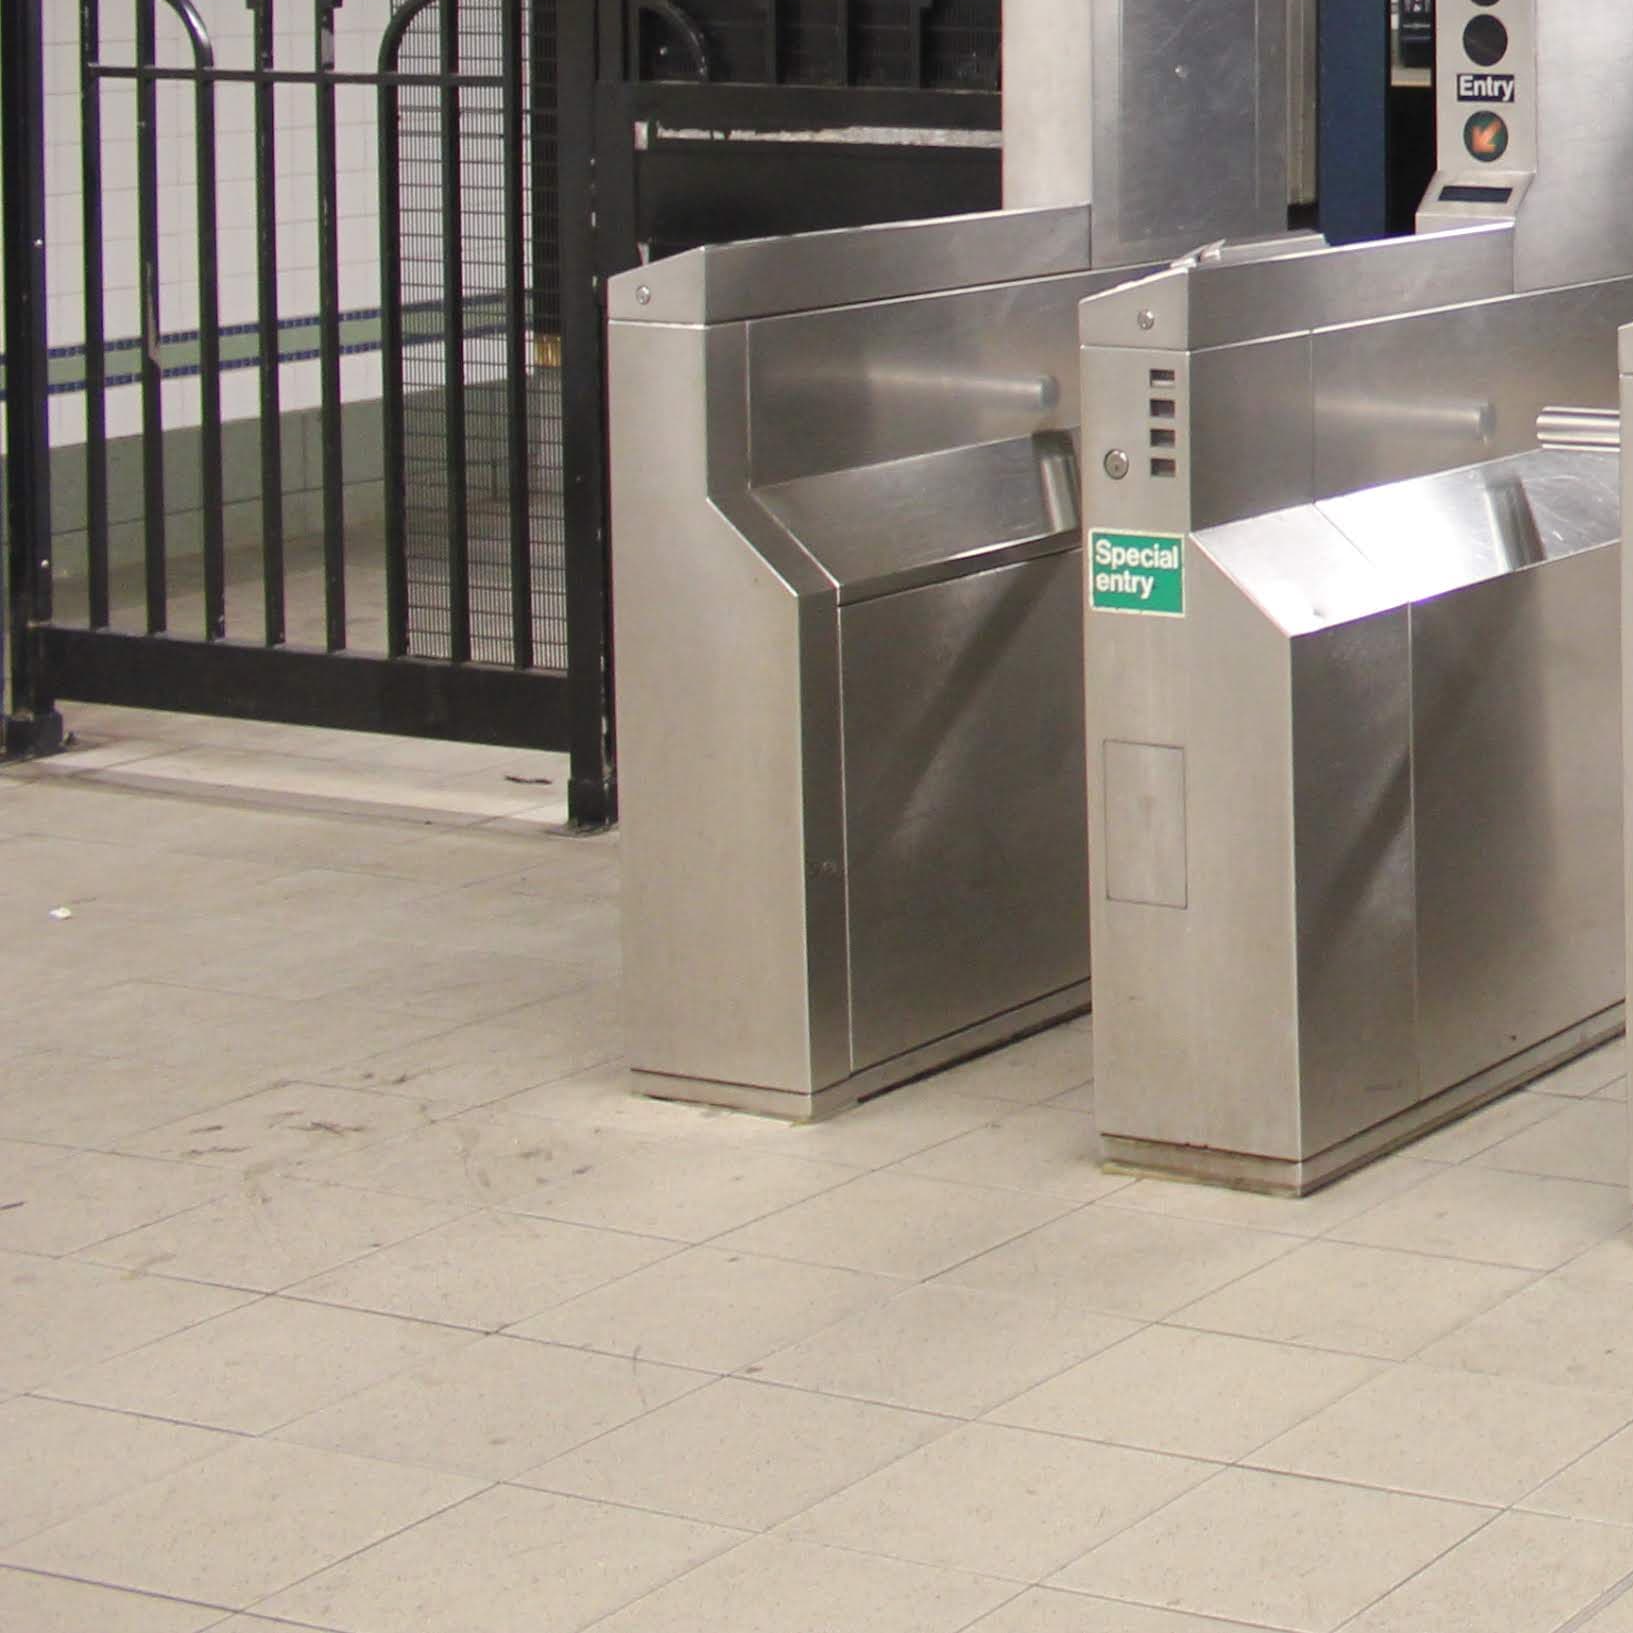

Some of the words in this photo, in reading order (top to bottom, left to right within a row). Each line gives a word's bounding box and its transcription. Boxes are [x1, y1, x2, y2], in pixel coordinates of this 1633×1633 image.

[1459, 75, 1514, 101] Entry
[1095, 538, 1179, 569] Special
[1096, 569, 1155, 599] entry
